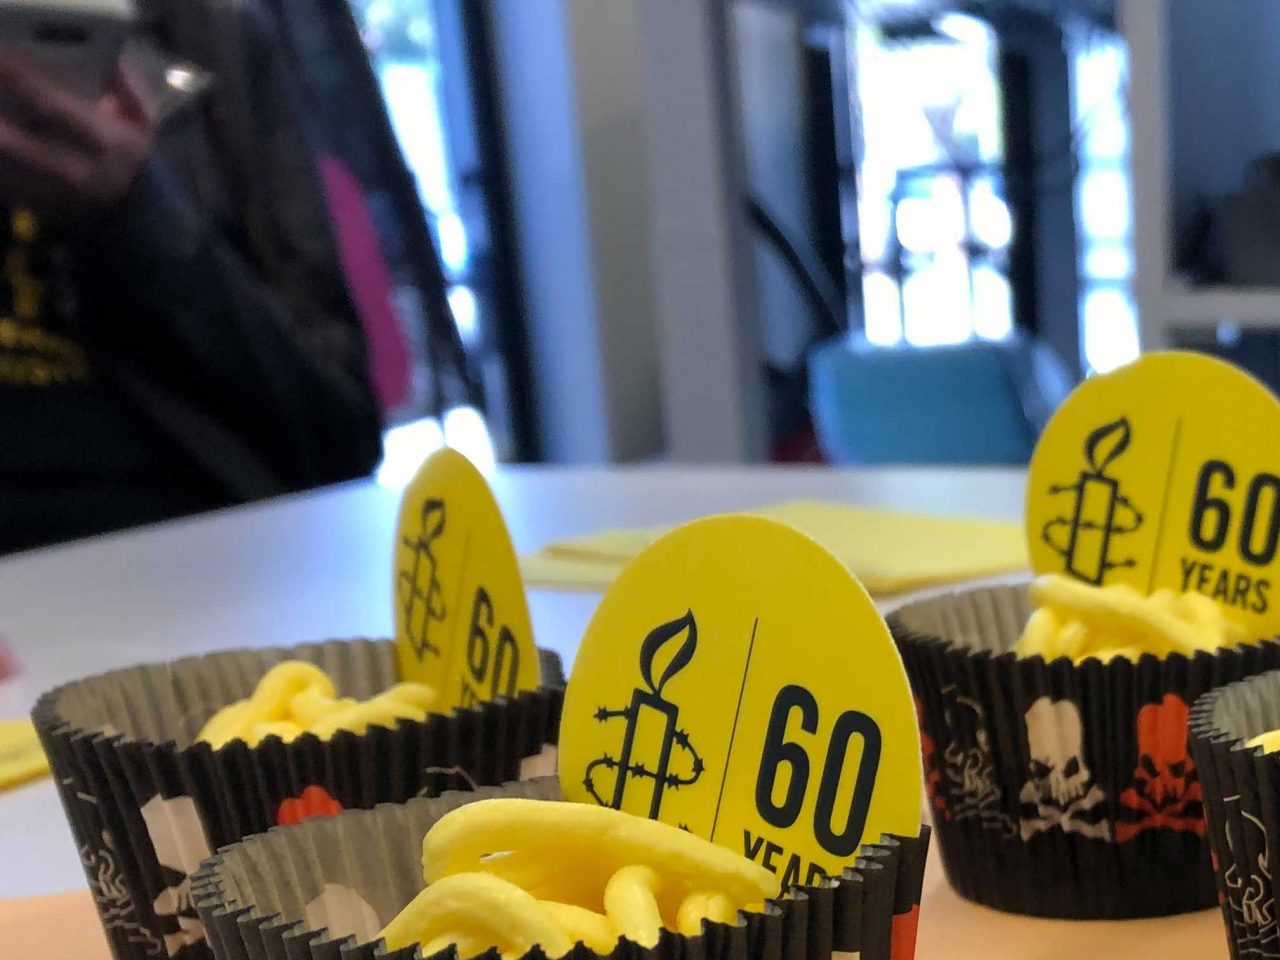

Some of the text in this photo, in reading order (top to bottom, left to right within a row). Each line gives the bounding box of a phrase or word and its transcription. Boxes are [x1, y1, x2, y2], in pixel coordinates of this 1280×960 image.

[1180, 556, 1270, 614] YEARS
[467, 586, 520, 698] 60
[755, 684, 882, 857] 60
[743, 829, 828, 899] YEA
